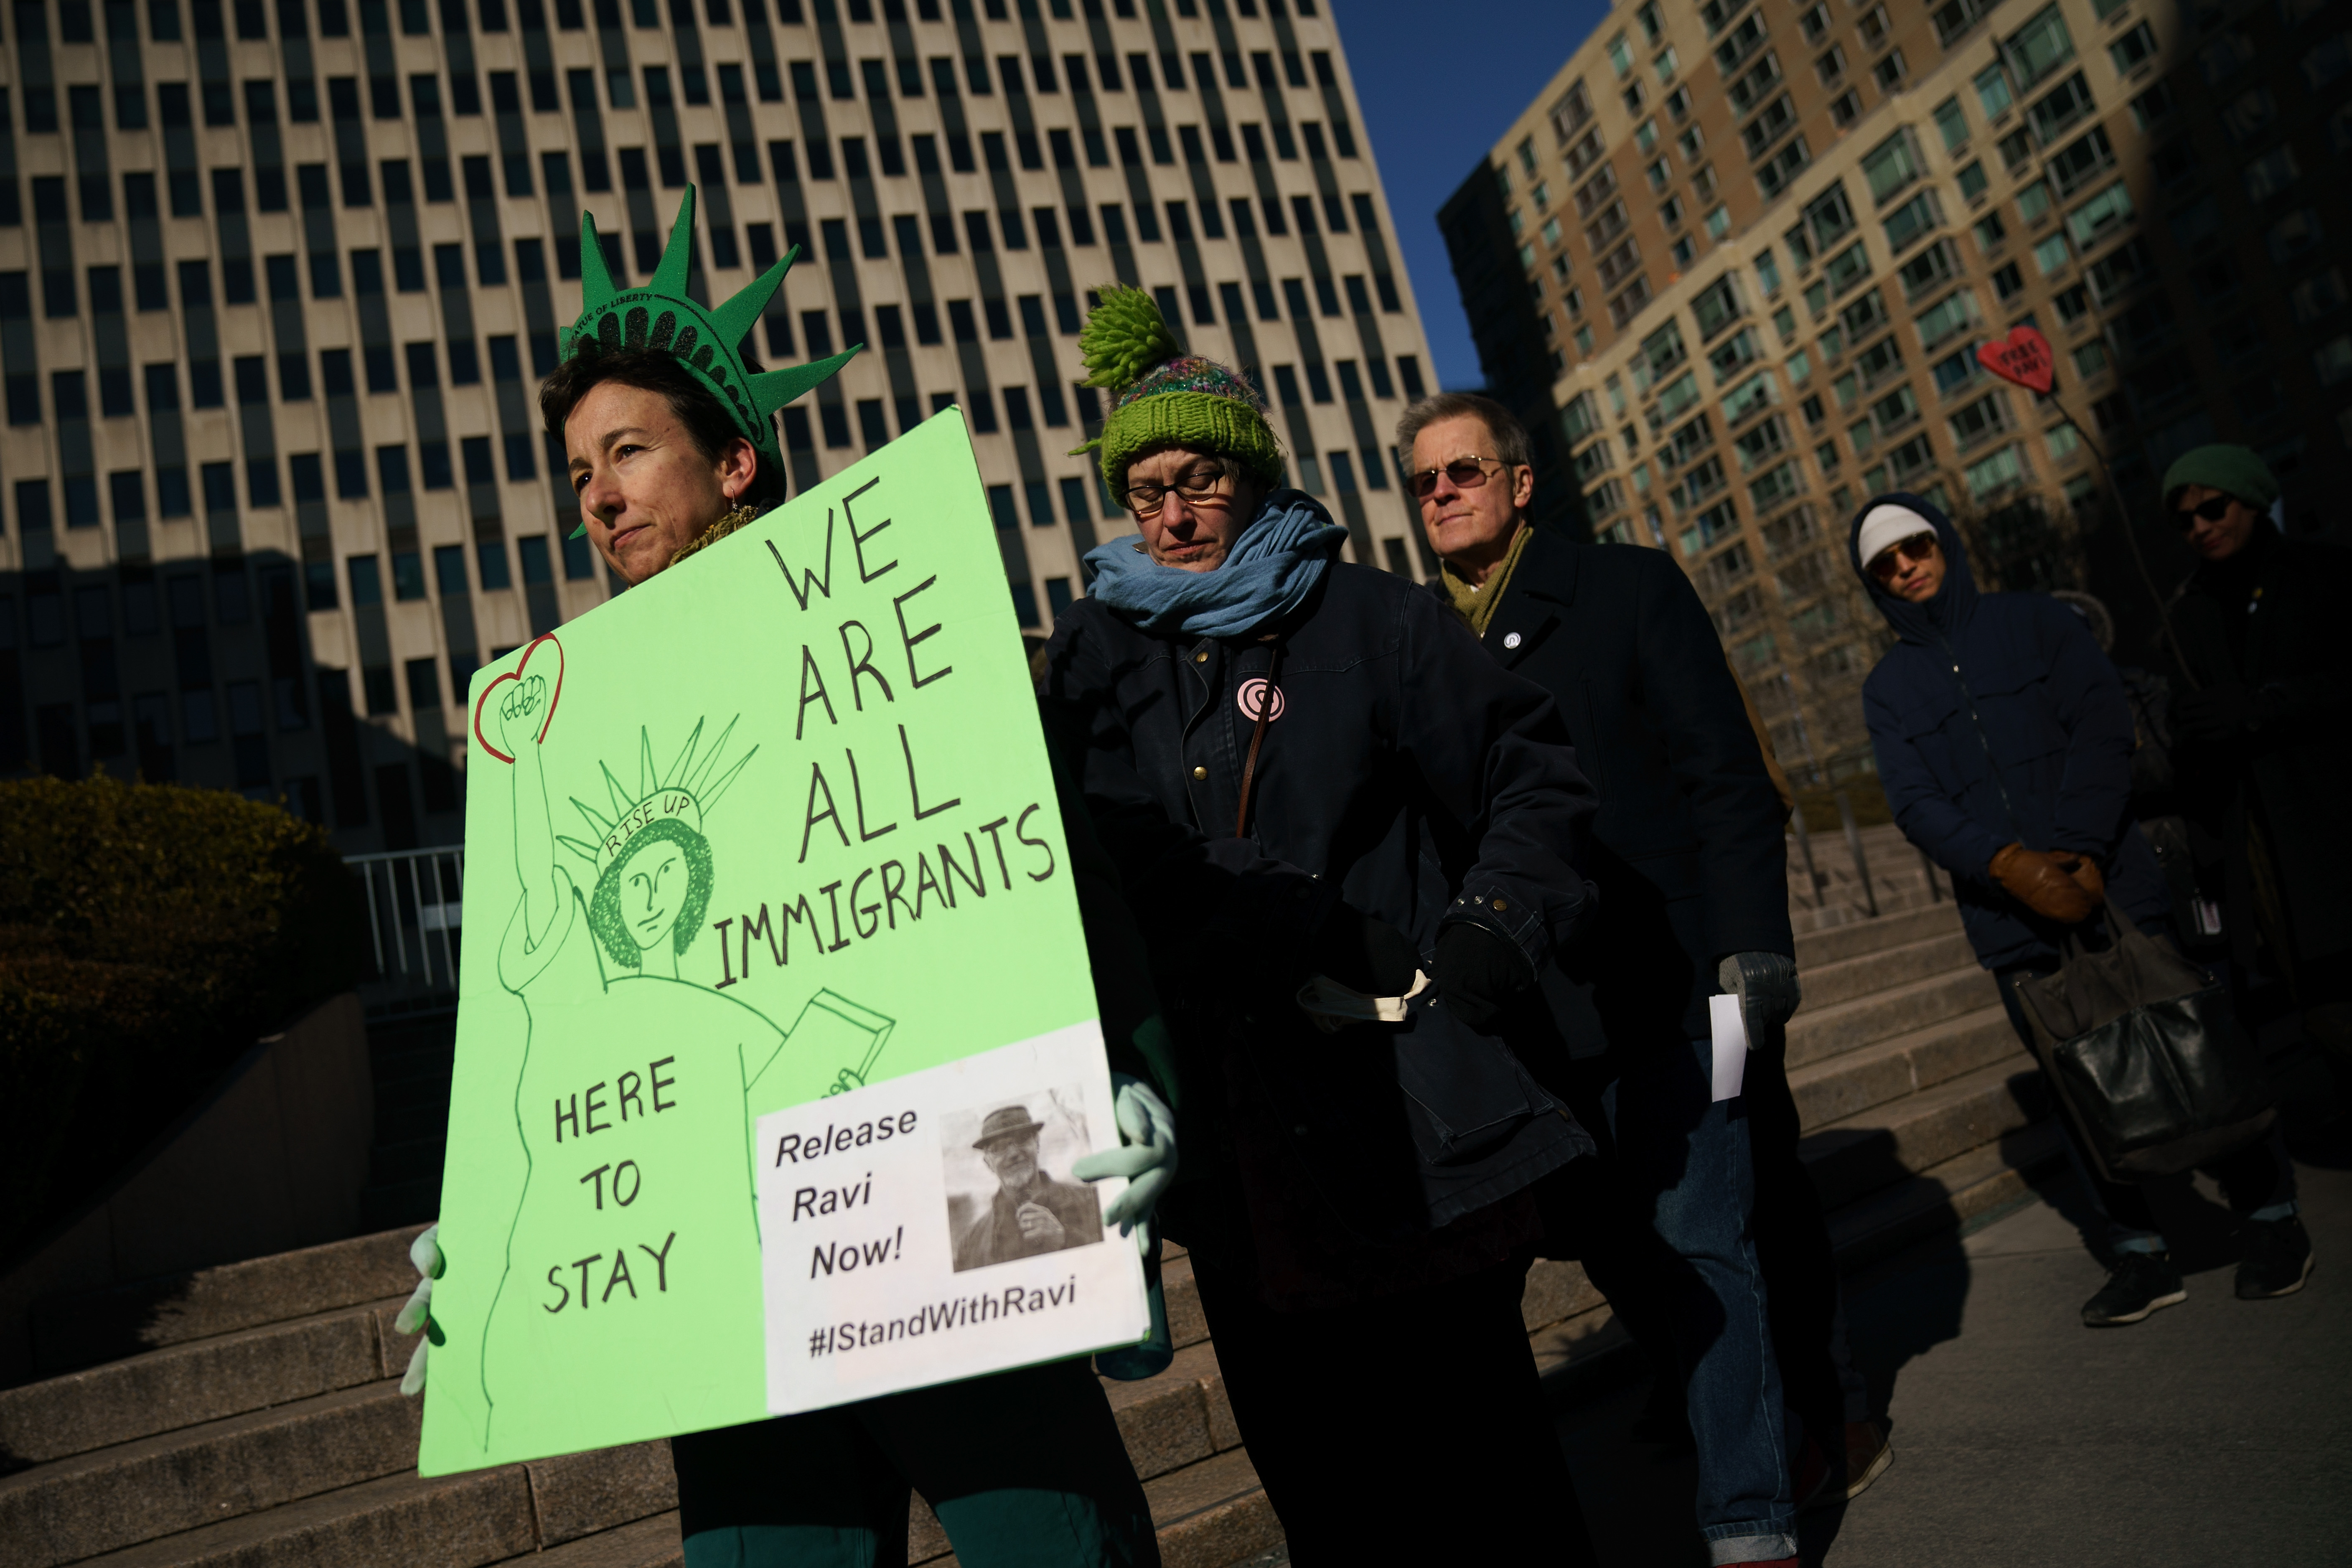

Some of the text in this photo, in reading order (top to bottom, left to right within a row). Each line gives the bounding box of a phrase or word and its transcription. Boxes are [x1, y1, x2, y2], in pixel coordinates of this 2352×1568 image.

[570, 293, 653, 348] TATUE OF LIBERTY
[765, 476, 898, 611] WE
[796, 574, 953, 740] ARE
[606, 794, 689, 857] RISE UP
[798, 724, 961, 864] ALL
[713, 802, 1055, 990] IMMIGRANTS
[555, 1055, 676, 1144] HERE
[775, 1110, 917, 1168] Release
[580, 1159, 641, 1210] TO
[792, 1172, 872, 1222] Ravi
[543, 1231, 676, 1313] STAY
[810, 1225, 903, 1280] Now!
[809, 1275, 1077, 1358] #IStandWithRavi
